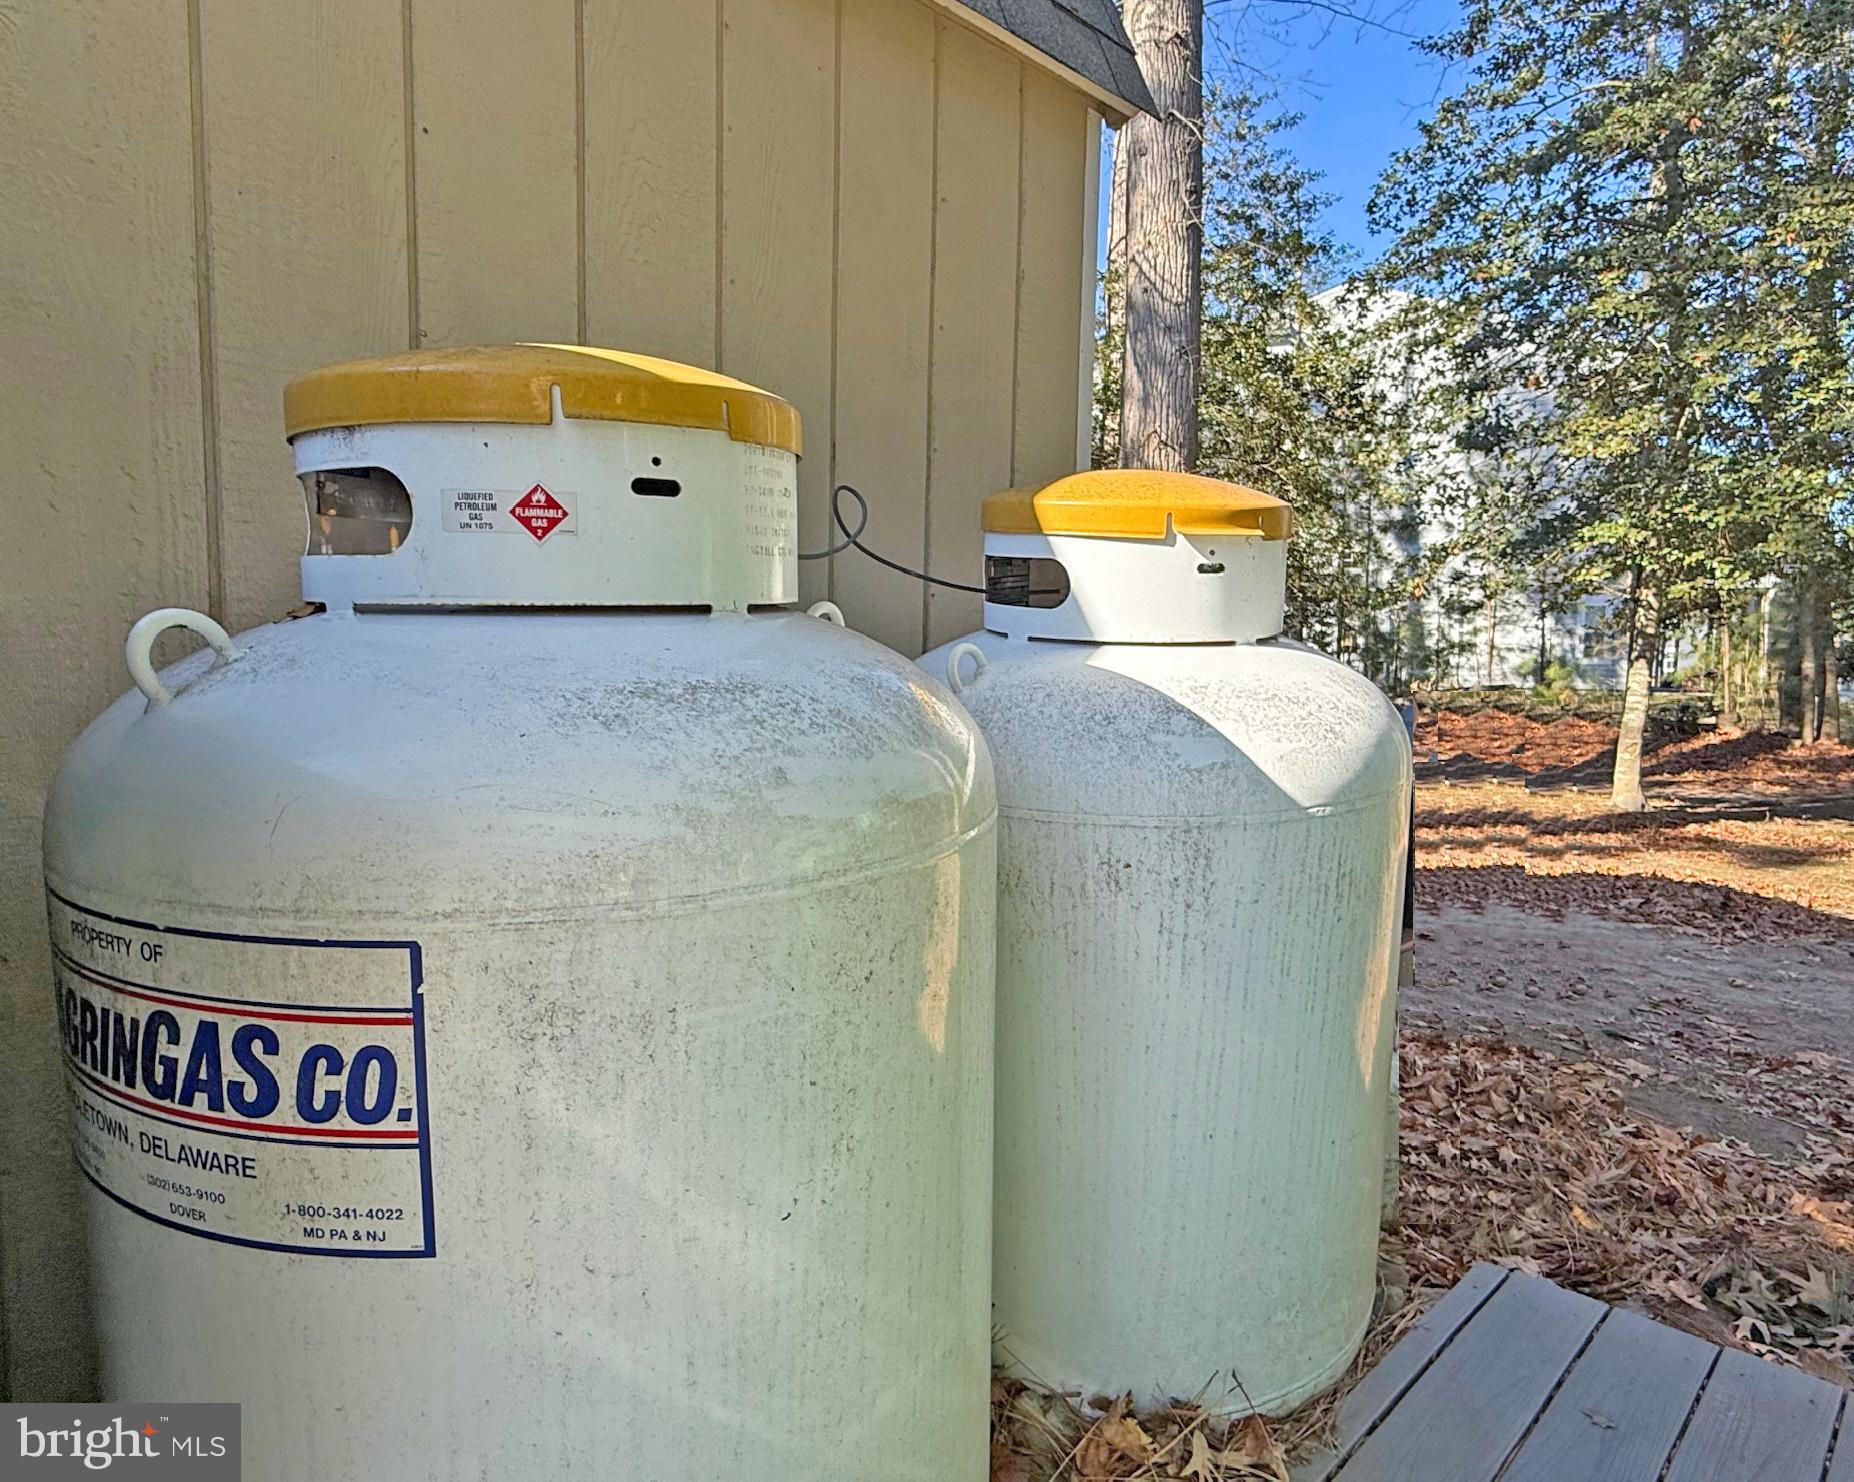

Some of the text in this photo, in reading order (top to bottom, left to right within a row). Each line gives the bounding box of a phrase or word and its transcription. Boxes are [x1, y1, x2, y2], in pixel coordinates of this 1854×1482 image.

[457, 492, 494, 501] LIQUEFIED
[454, 501, 498, 512] PETROLEUM
[515, 506, 564, 519] FLAMMABLE
[468, 512, 483, 521] GAS
[531, 518, 548, 528] GAS
[459, 522, 494, 530] UN 1075
[536, 528, 543, 537] 2
[70, 920, 163, 963] PROPERTY OF
[61, 985, 413, 1126] GRINGAS CO.
[139, 1131, 258, 1179] DELAWARE
[169, 1202, 207, 1222] DOVER
[284, 1203, 404, 1221] 1-800-341-4022
[303, 1227, 387, 1242] MD PA & NJ
